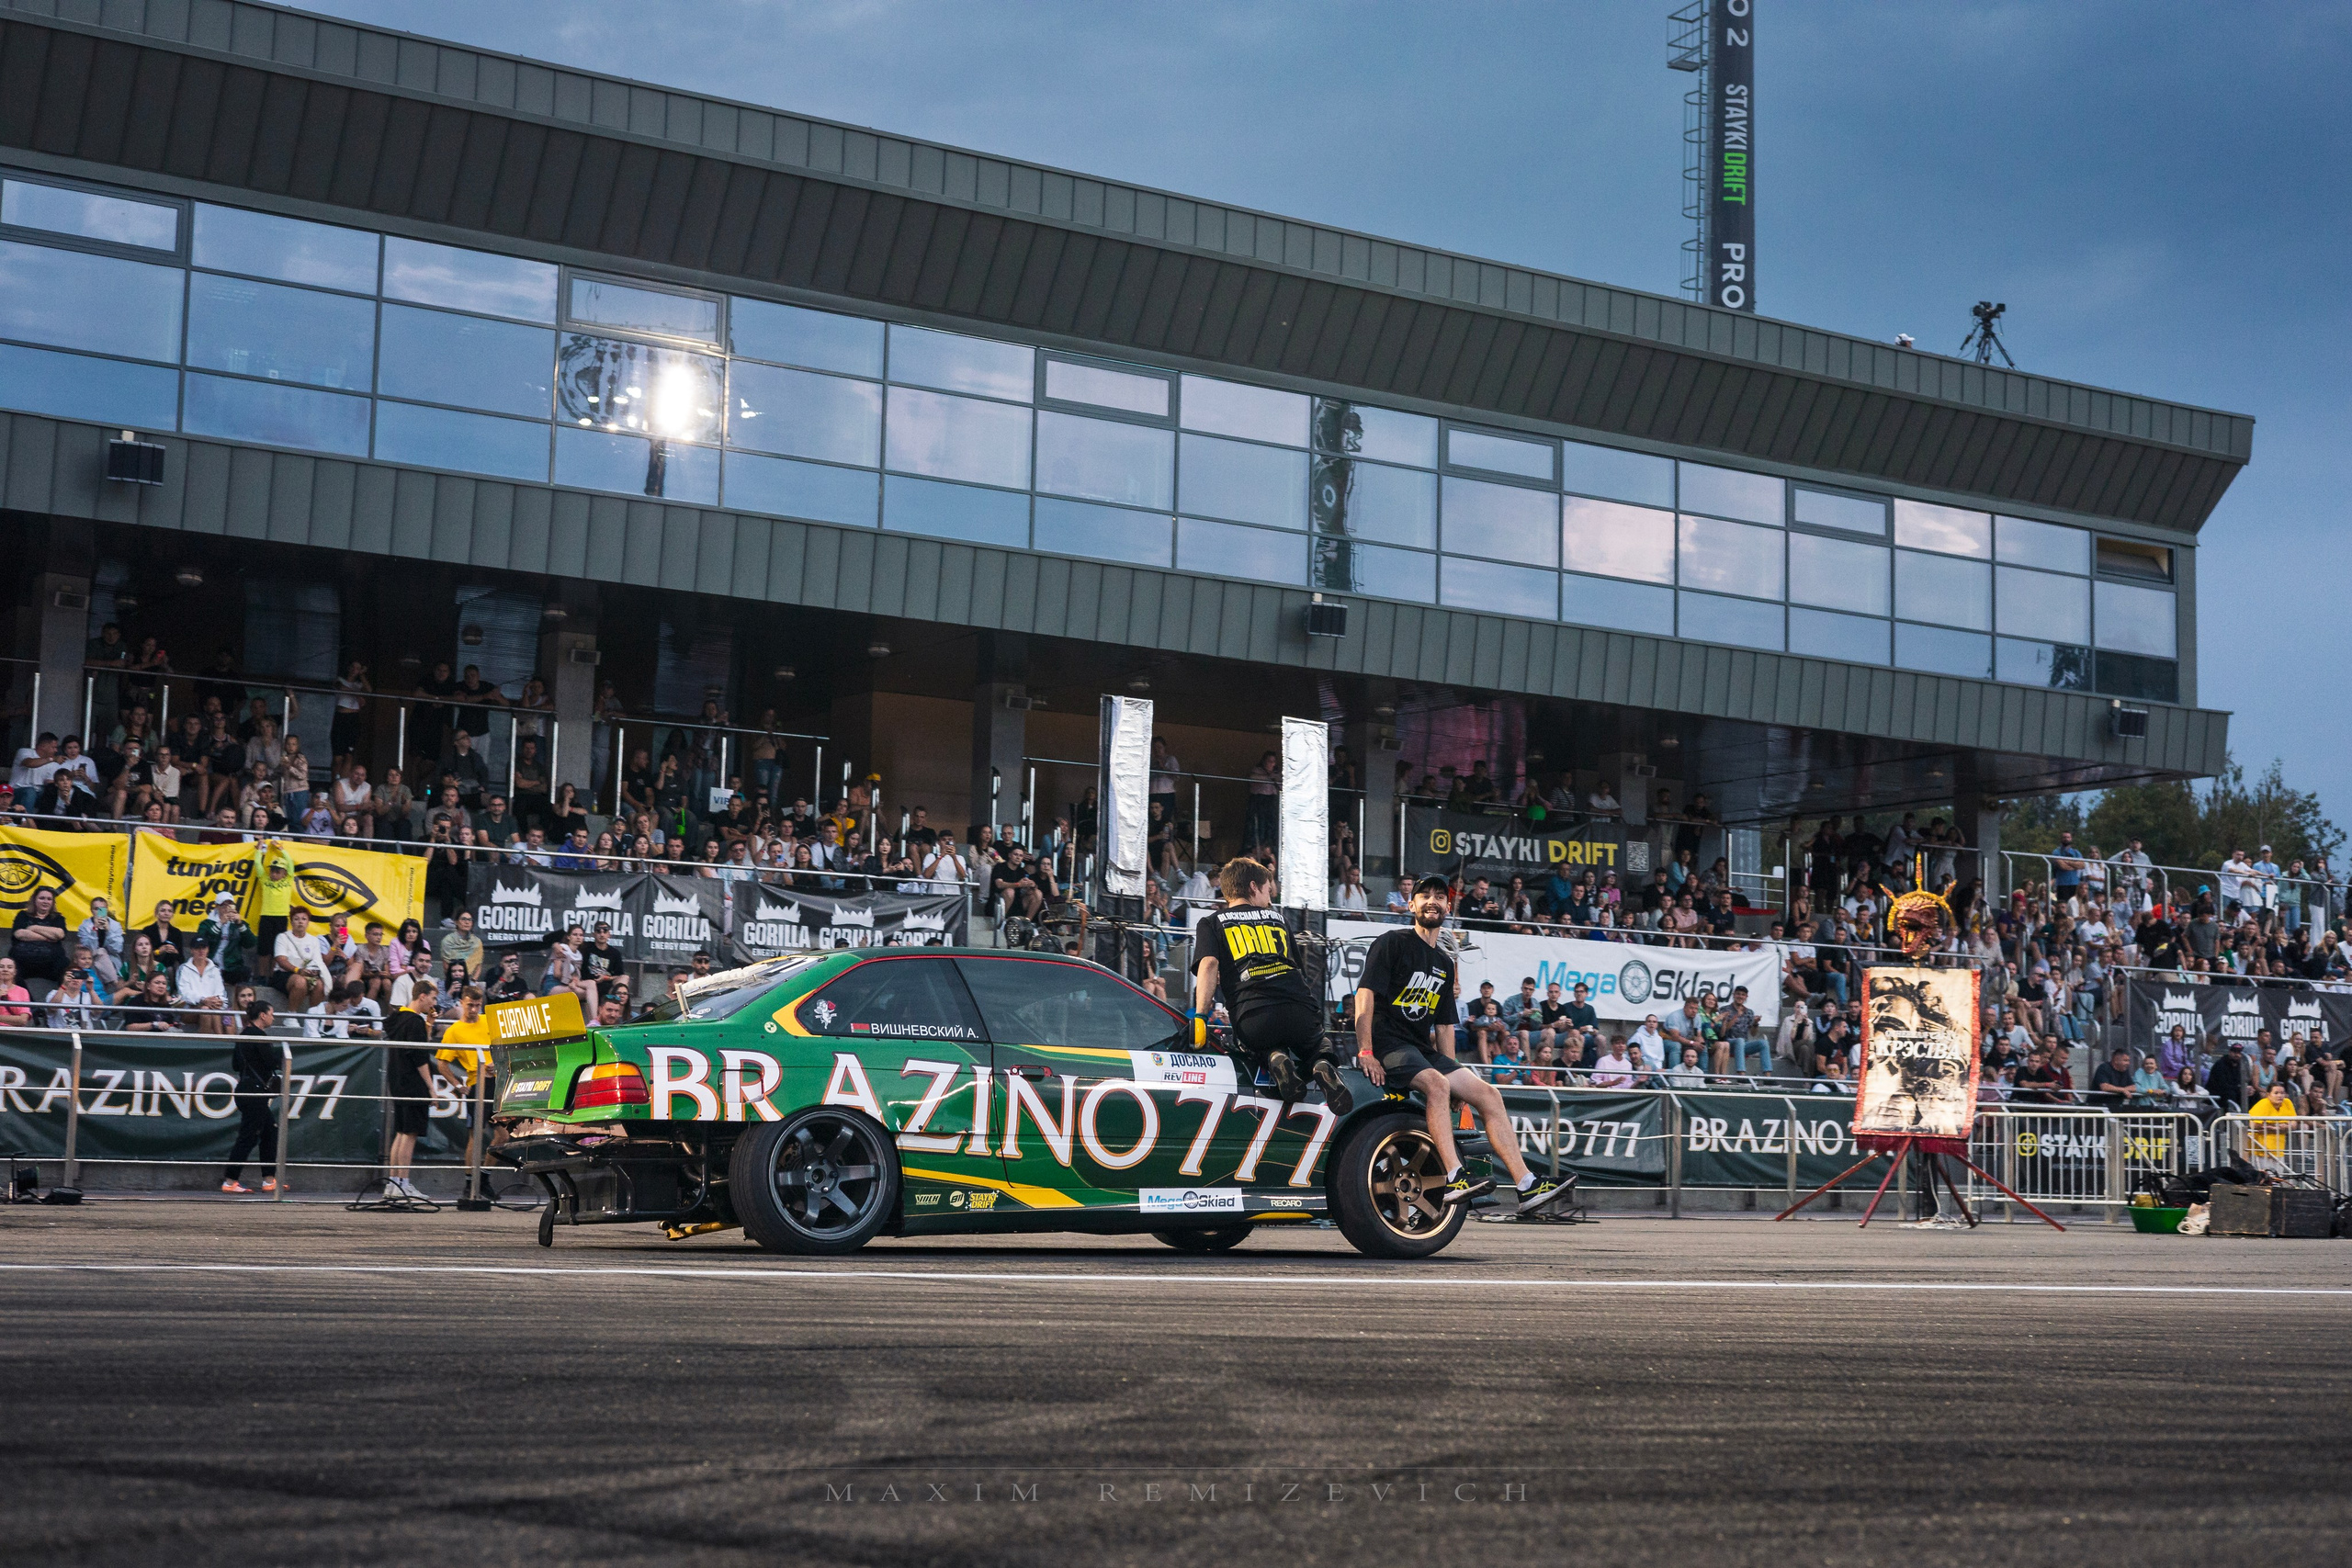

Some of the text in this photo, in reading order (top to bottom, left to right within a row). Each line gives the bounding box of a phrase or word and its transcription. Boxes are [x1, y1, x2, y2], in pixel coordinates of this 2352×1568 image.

[1727, 28, 1749, 47] 2
[1722, 243, 1746, 309] PRO
[1455, 831, 1619, 866] STAYKI DRIFT
[166, 856, 254, 879] tuning
[195, 878, 249, 897] you
[477, 905, 555, 932] GORILLA
[1217, 909, 1261, 923] BLOCKCHAIN
[487, 932, 518, 942] ENERGY
[642, 914, 712, 942] GORILLA
[743, 921, 811, 948] GORILLA
[650, 941, 679, 951] ENERGY
[1224, 924, 1288, 961] DRIFT
[1535, 960, 1736, 1003] Mega Sklad
[496, 1003, 552, 1039] EUROMILF
[871, 1021, 979, 1039] ВИШНЕВСКИЙ А.
[1170, 1054, 1217, 1068] ДОСААФ
[2041, 1134, 2108, 1159] STAYK
[970, 1201, 995, 1209] DRIFT
[1148, 1195, 1182, 1210] Mega
[1270, 1200, 1302, 1208] RECARO
